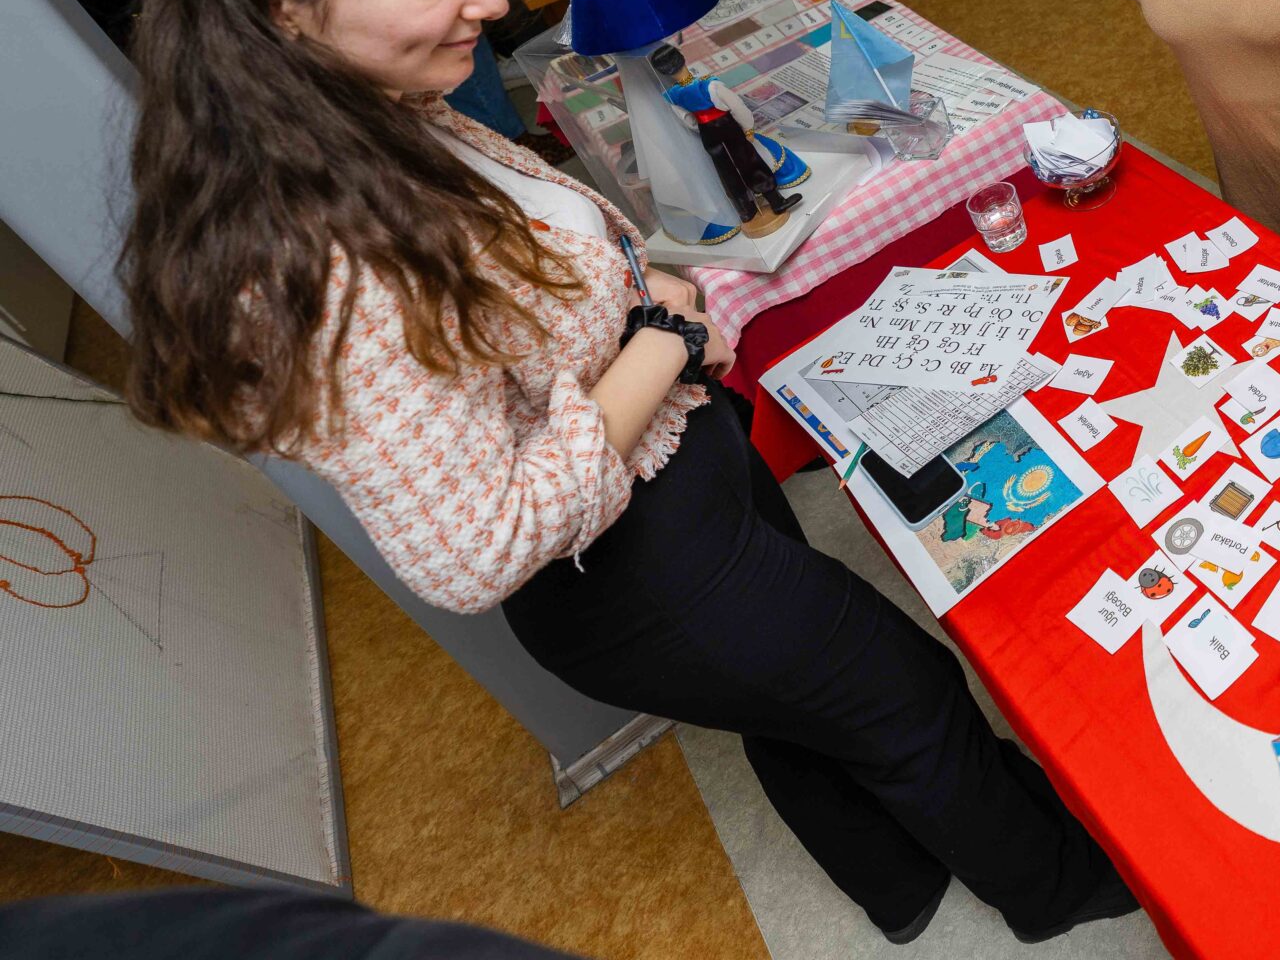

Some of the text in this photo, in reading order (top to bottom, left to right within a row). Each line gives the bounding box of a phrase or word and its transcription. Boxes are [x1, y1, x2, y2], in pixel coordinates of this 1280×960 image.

[914, 300, 932, 315] Ss
[936, 303, 957, 316] Rr
[963, 304, 985, 319] Pp
[990, 307, 1014, 323] Öö
[859, 315, 883, 329] Nn
[889, 316, 922, 332] Mm
[1021, 309, 1044, 323] Oo
[926, 319, 945, 334] Ll
[950, 321, 972, 336] Kk
[976, 321, 995, 338] Jj
[875, 335, 900, 350] Hh
[936, 337, 961, 354] Gg
[962, 342, 986, 356] Ff
[834, 350, 1003, 376] Aa Bb Cc Çç Dd Ee
[1247, 383, 1267, 403] Ördek
[1077, 414, 1101, 439] Tekerlek
[1210, 532, 1249, 555] Portakal
[1102, 590, 1133, 618] Böceği
[1098, 607, 1119, 628] Uğur
[1208, 635, 1231, 661] Balık
